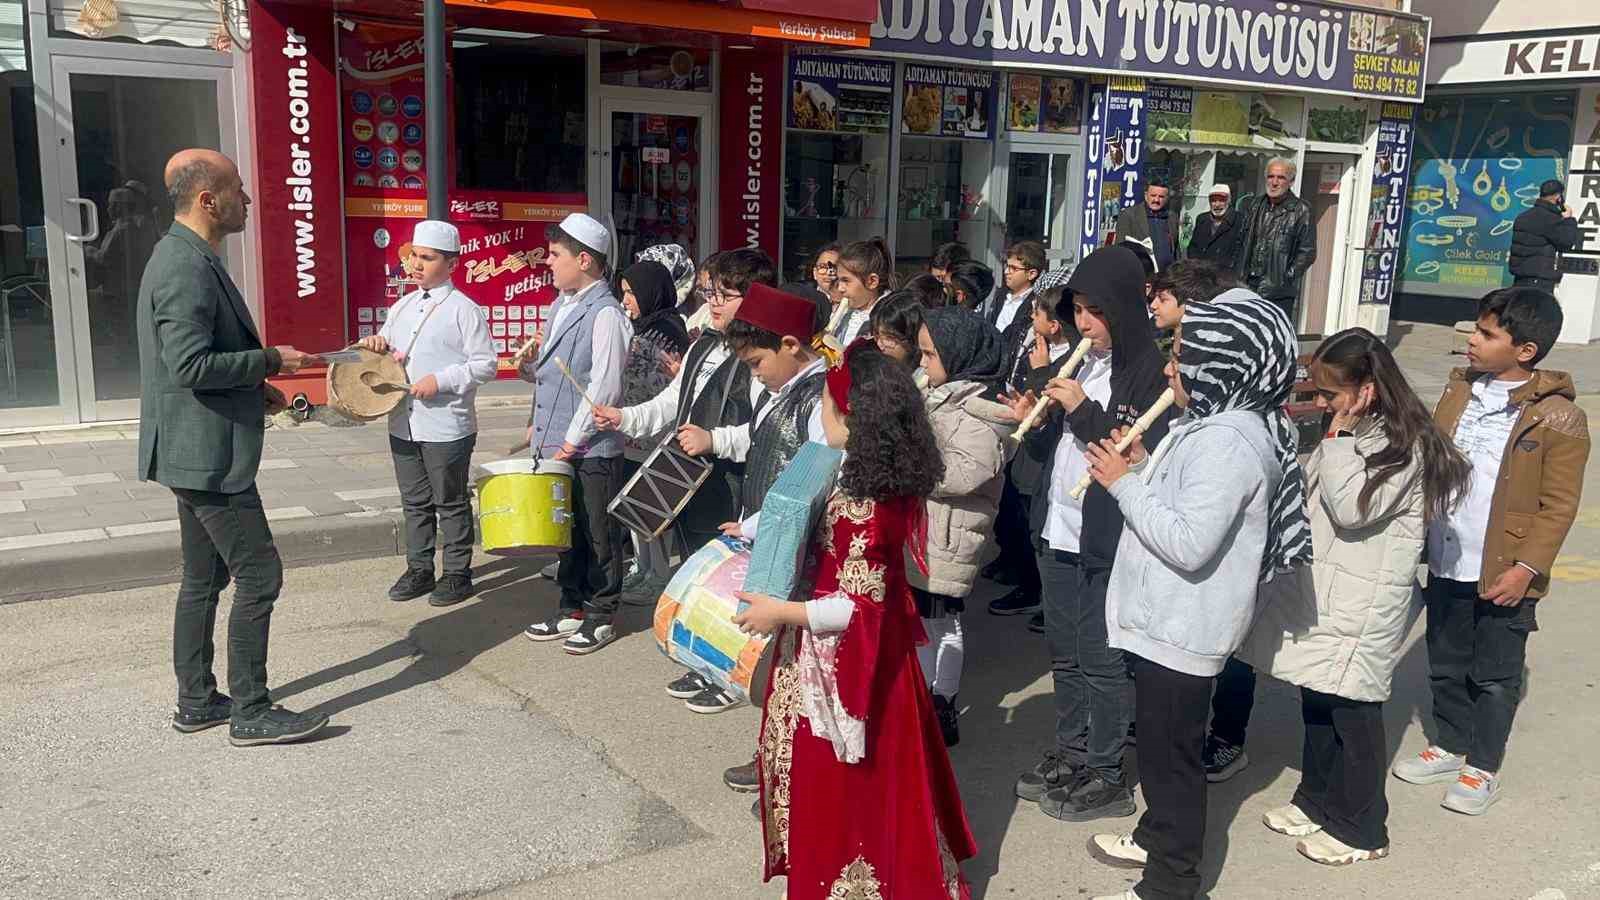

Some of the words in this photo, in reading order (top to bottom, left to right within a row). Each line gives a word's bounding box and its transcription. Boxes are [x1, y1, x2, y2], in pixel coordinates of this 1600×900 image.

[778, 21, 817, 40] Yerköy
[819, 24, 856, 42] Şubesi
[794, 60, 841, 79] ADIYAMAN
[843, 61, 891, 83] TÜTÜNCÜSÜ
[904, 65, 946, 86] ADIYAMAN
[1391, 57, 1420, 76] SALAN
[1352, 74, 1375, 91] 0553
[1376, 76, 1392, 92] 494
[1393, 78, 1405, 94] 75
[1405, 79, 1418, 96] 82
[283, 27, 316, 298] www.isler.com.tr
[743, 72, 764, 250] w.isler.com.tr
[371, 202, 402, 212] YERKÖY
[459, 238, 481, 255] nik
[484, 229, 512, 249] YOK
